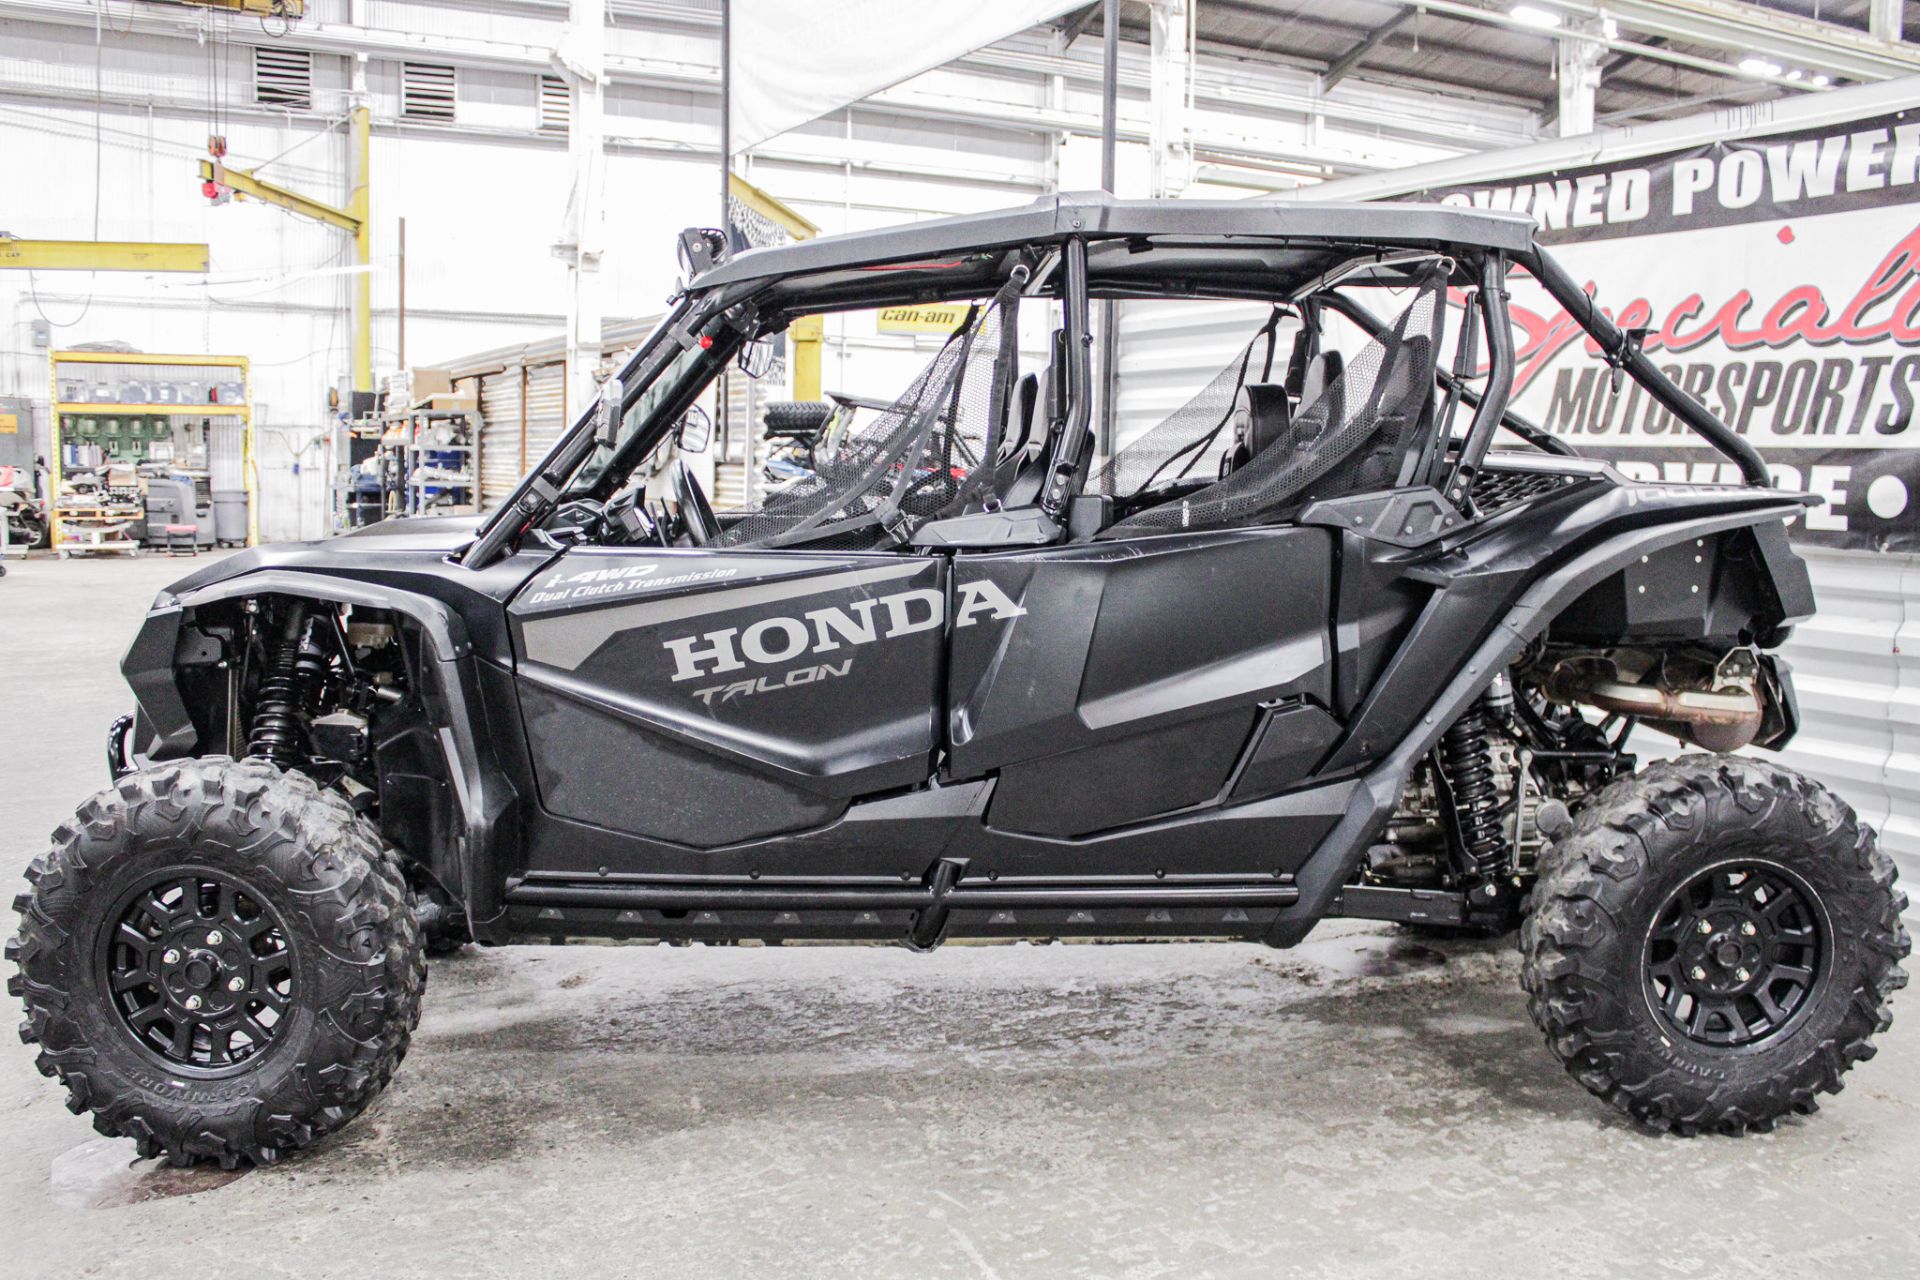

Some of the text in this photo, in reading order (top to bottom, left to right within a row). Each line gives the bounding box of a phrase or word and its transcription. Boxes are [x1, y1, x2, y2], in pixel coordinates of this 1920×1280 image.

[882, 309, 955, 324] can-am
[529, 568, 738, 604] Dual Clutch Transmission
[662, 579, 1028, 682] HONDA
[692, 658, 853, 706] TALON
[124, 1067, 251, 1104] CARNIVORE
